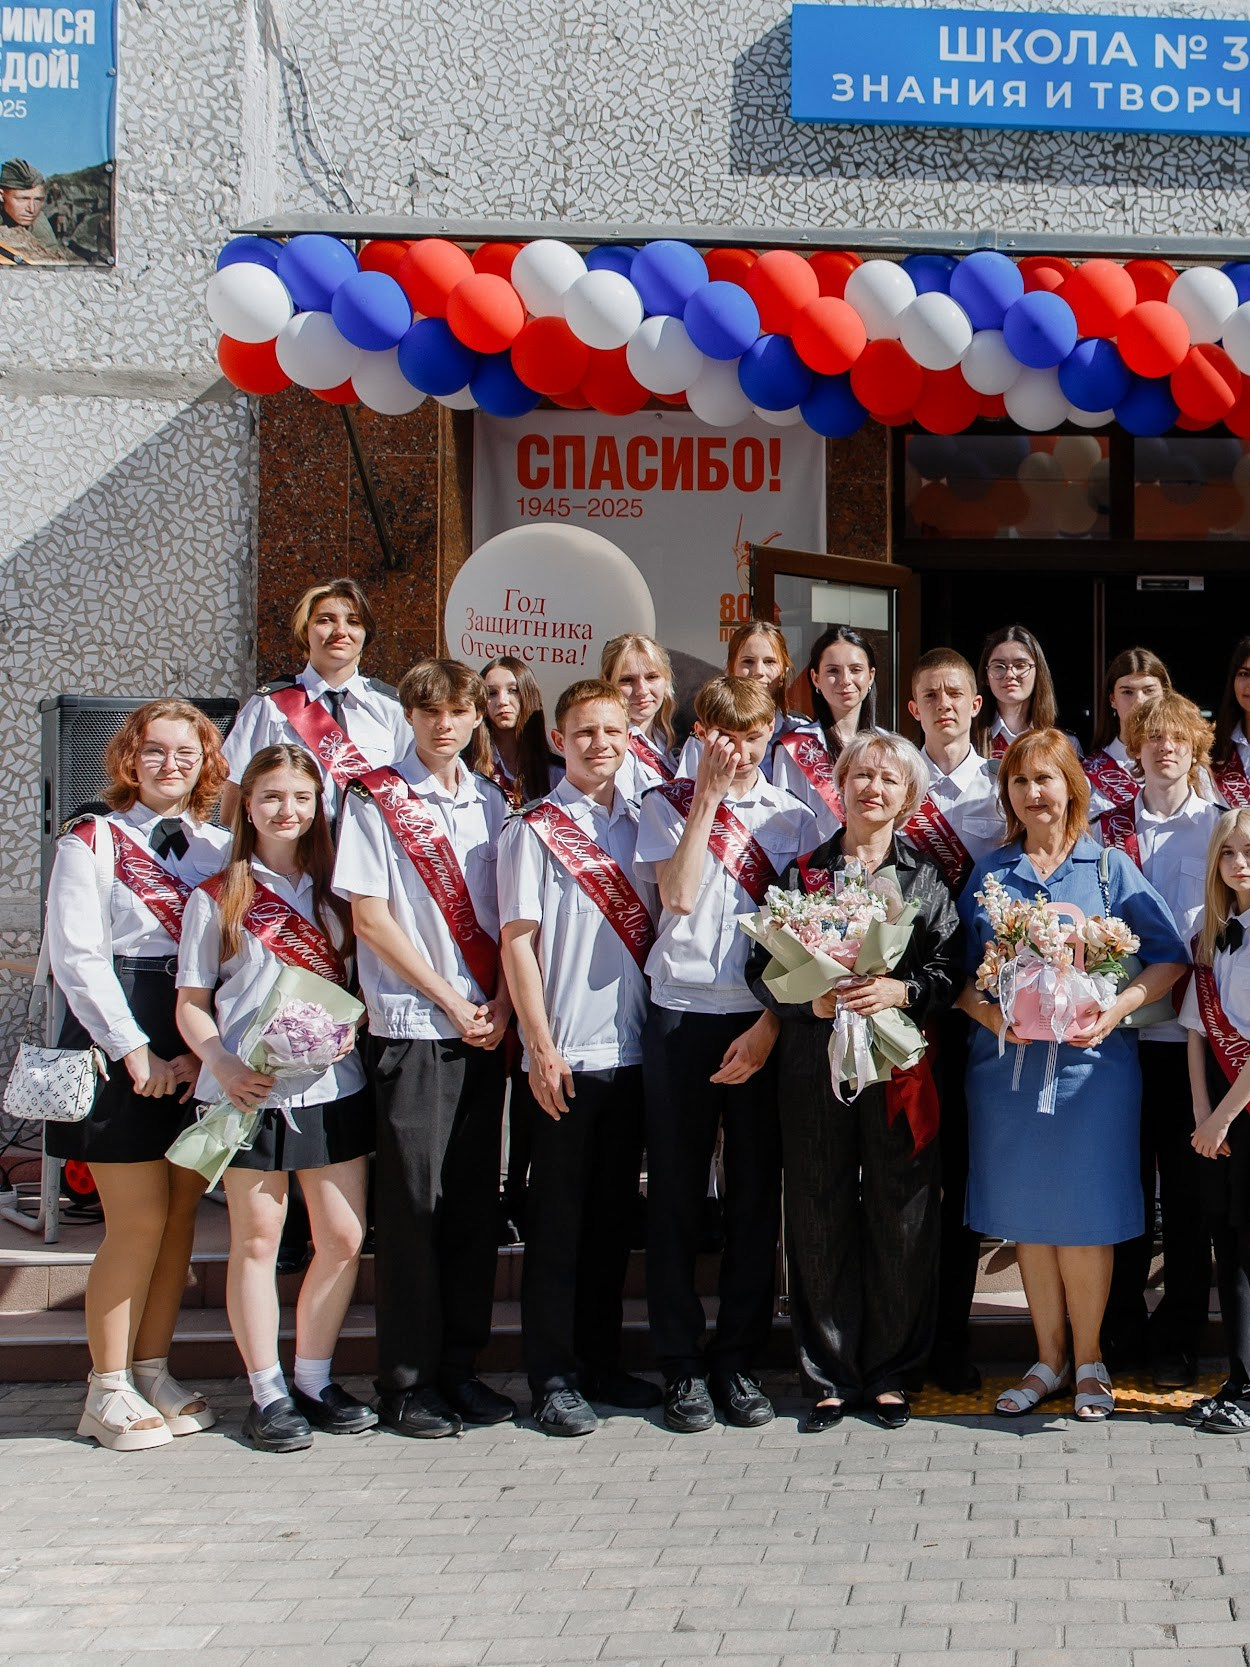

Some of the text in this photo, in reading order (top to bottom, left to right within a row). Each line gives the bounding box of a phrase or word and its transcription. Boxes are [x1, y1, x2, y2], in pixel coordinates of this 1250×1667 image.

[0, 7, 95, 46] ИМСЯ
[938, 25, 1138, 68] ШКОЛА
[1154, 32, 1208, 71] №
[0, 49, 79, 93] ДОЙ!
[831, 73, 1028, 109] ЗНАНИЯ
[1045, 82, 1072, 109] И
[516, 433, 782, 492] СПАСИБО!
[502, 588, 546, 617] Год
[720, 593, 750, 622] 80
[465, 607, 593, 640] Защитника
[461, 632, 587, 666] Отечества!
[395, 808, 457, 900] Выпускник
[448, 895, 482, 942] 2025
[551, 828, 627, 908] Выпускник
[616, 900, 654, 947] 2025
